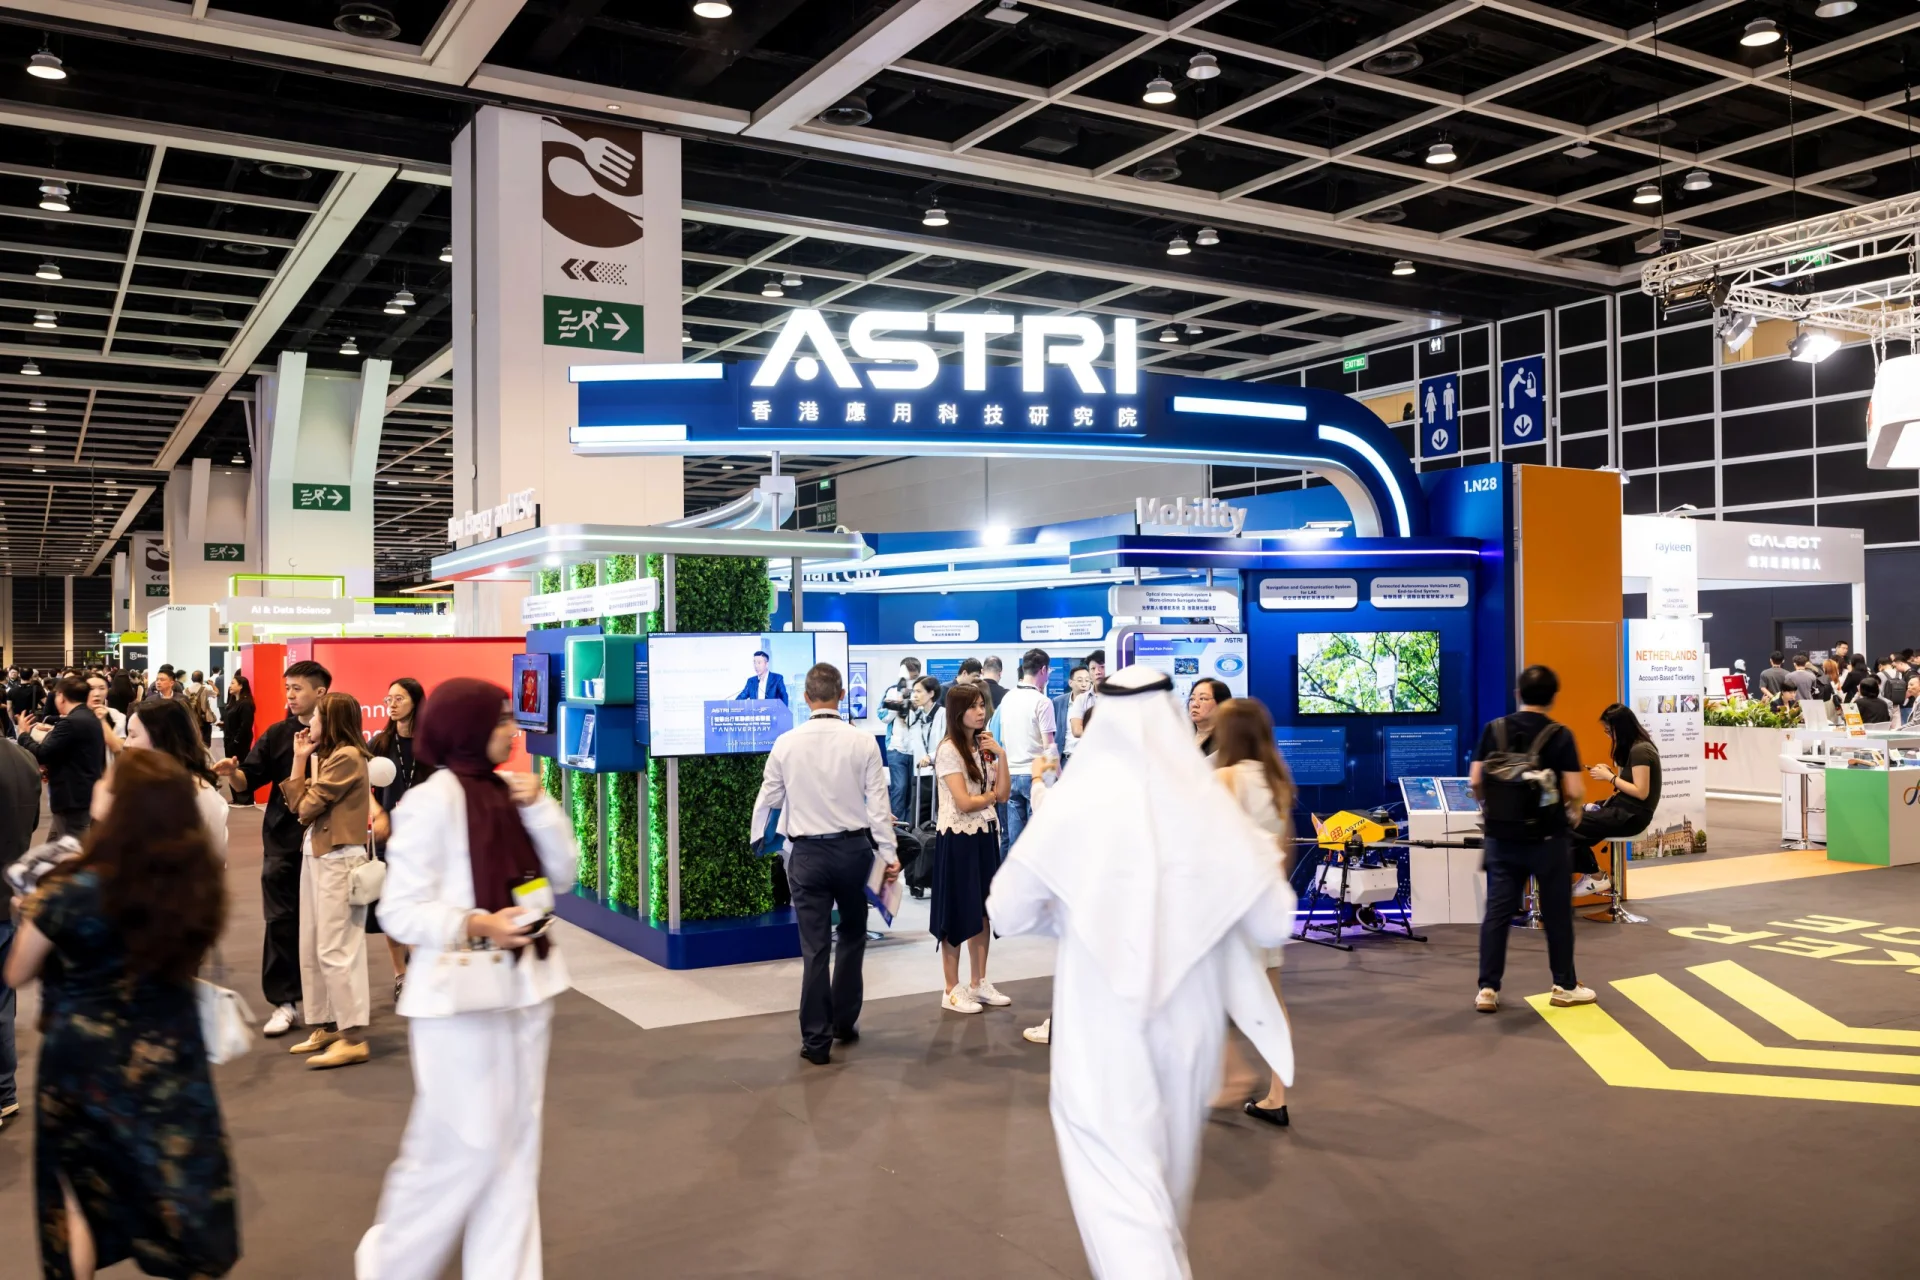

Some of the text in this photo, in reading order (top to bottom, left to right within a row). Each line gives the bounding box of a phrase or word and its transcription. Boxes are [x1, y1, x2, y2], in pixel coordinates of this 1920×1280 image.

[750, 309, 1138, 394] ASTRI
[751, 400, 1138, 428] 香港應用科技研究院
[1464, 477, 1497, 493] 1.N28
[1136, 497, 1247, 535] Mobility
[1656, 542, 1692, 554] raykeen
[252, 606, 261, 614] AI
[273, 606, 294, 614] Data
[296, 606, 332, 614] Science
[1636, 650, 1697, 660] NETHERLANDS
[1704, 742, 1727, 760] HK
